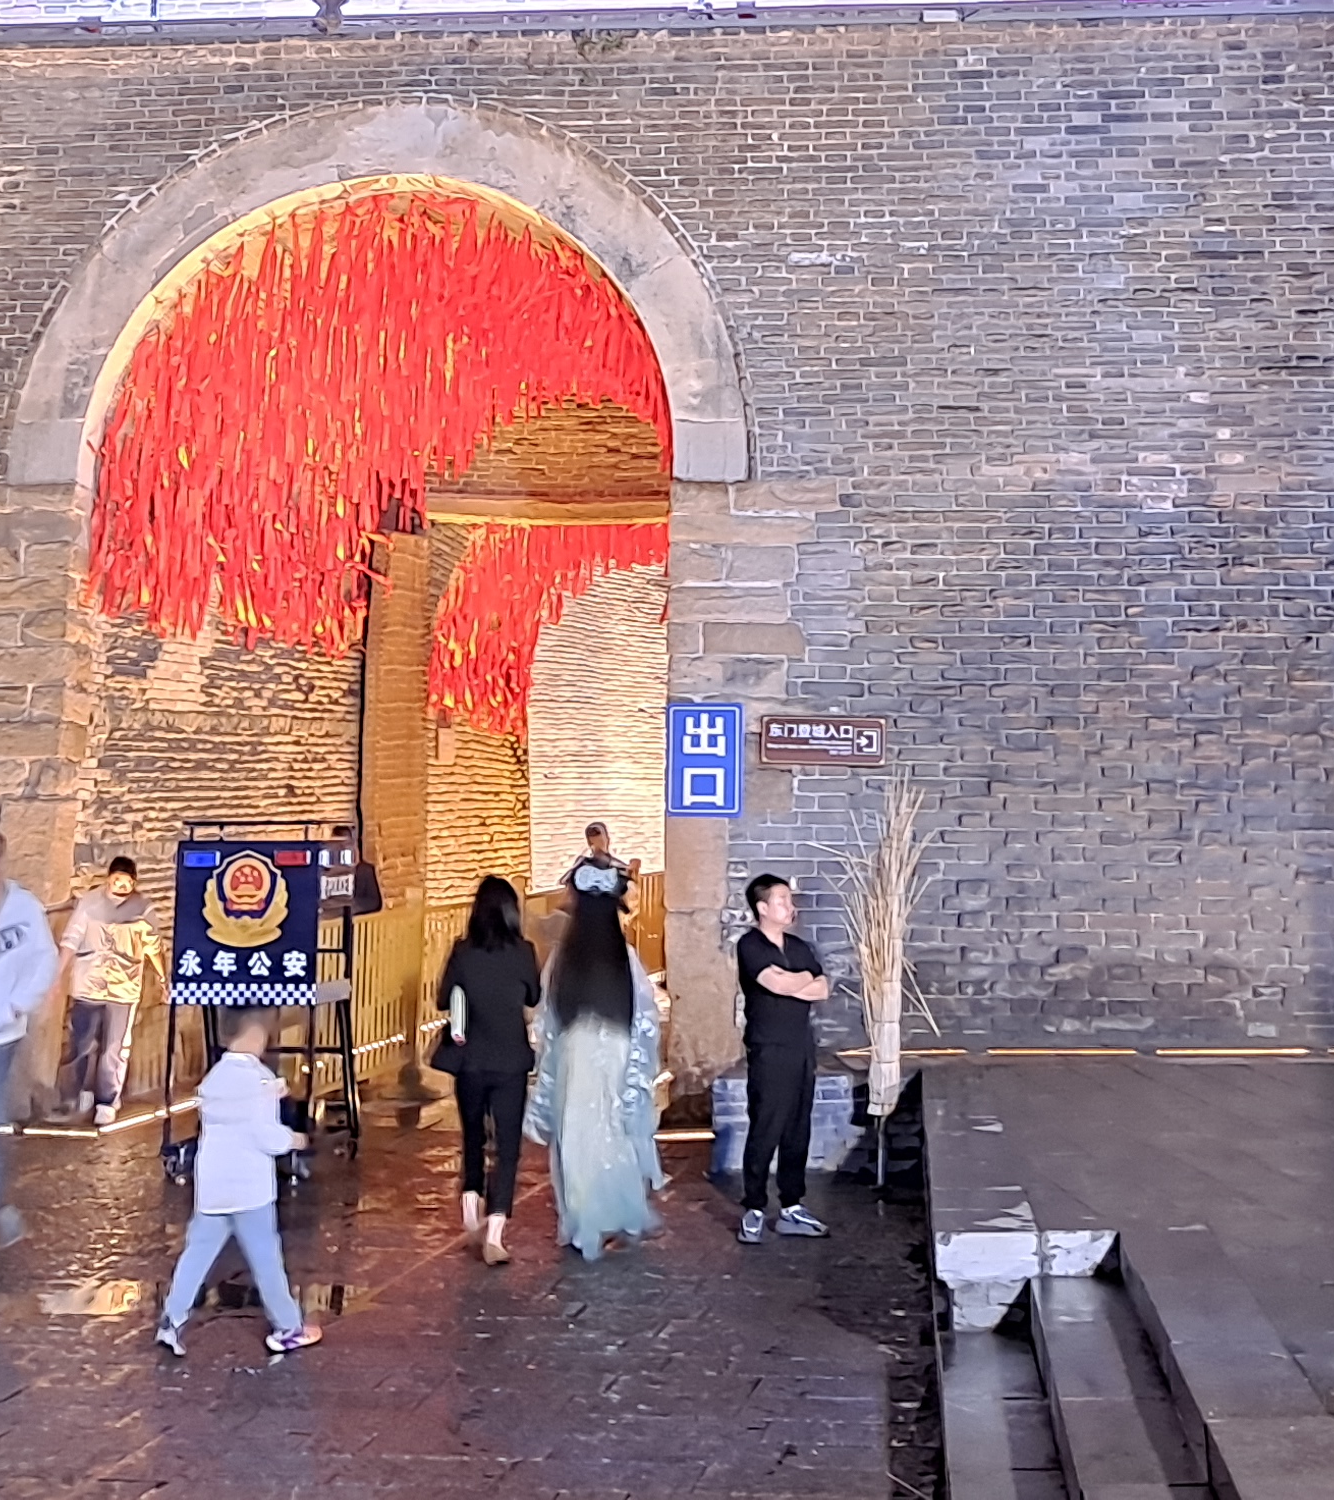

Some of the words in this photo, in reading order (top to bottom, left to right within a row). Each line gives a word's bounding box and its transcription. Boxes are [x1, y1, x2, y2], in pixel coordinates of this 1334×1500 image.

[682, 712, 727, 806] 出口
[177, 949, 308, 978] 永年公安
